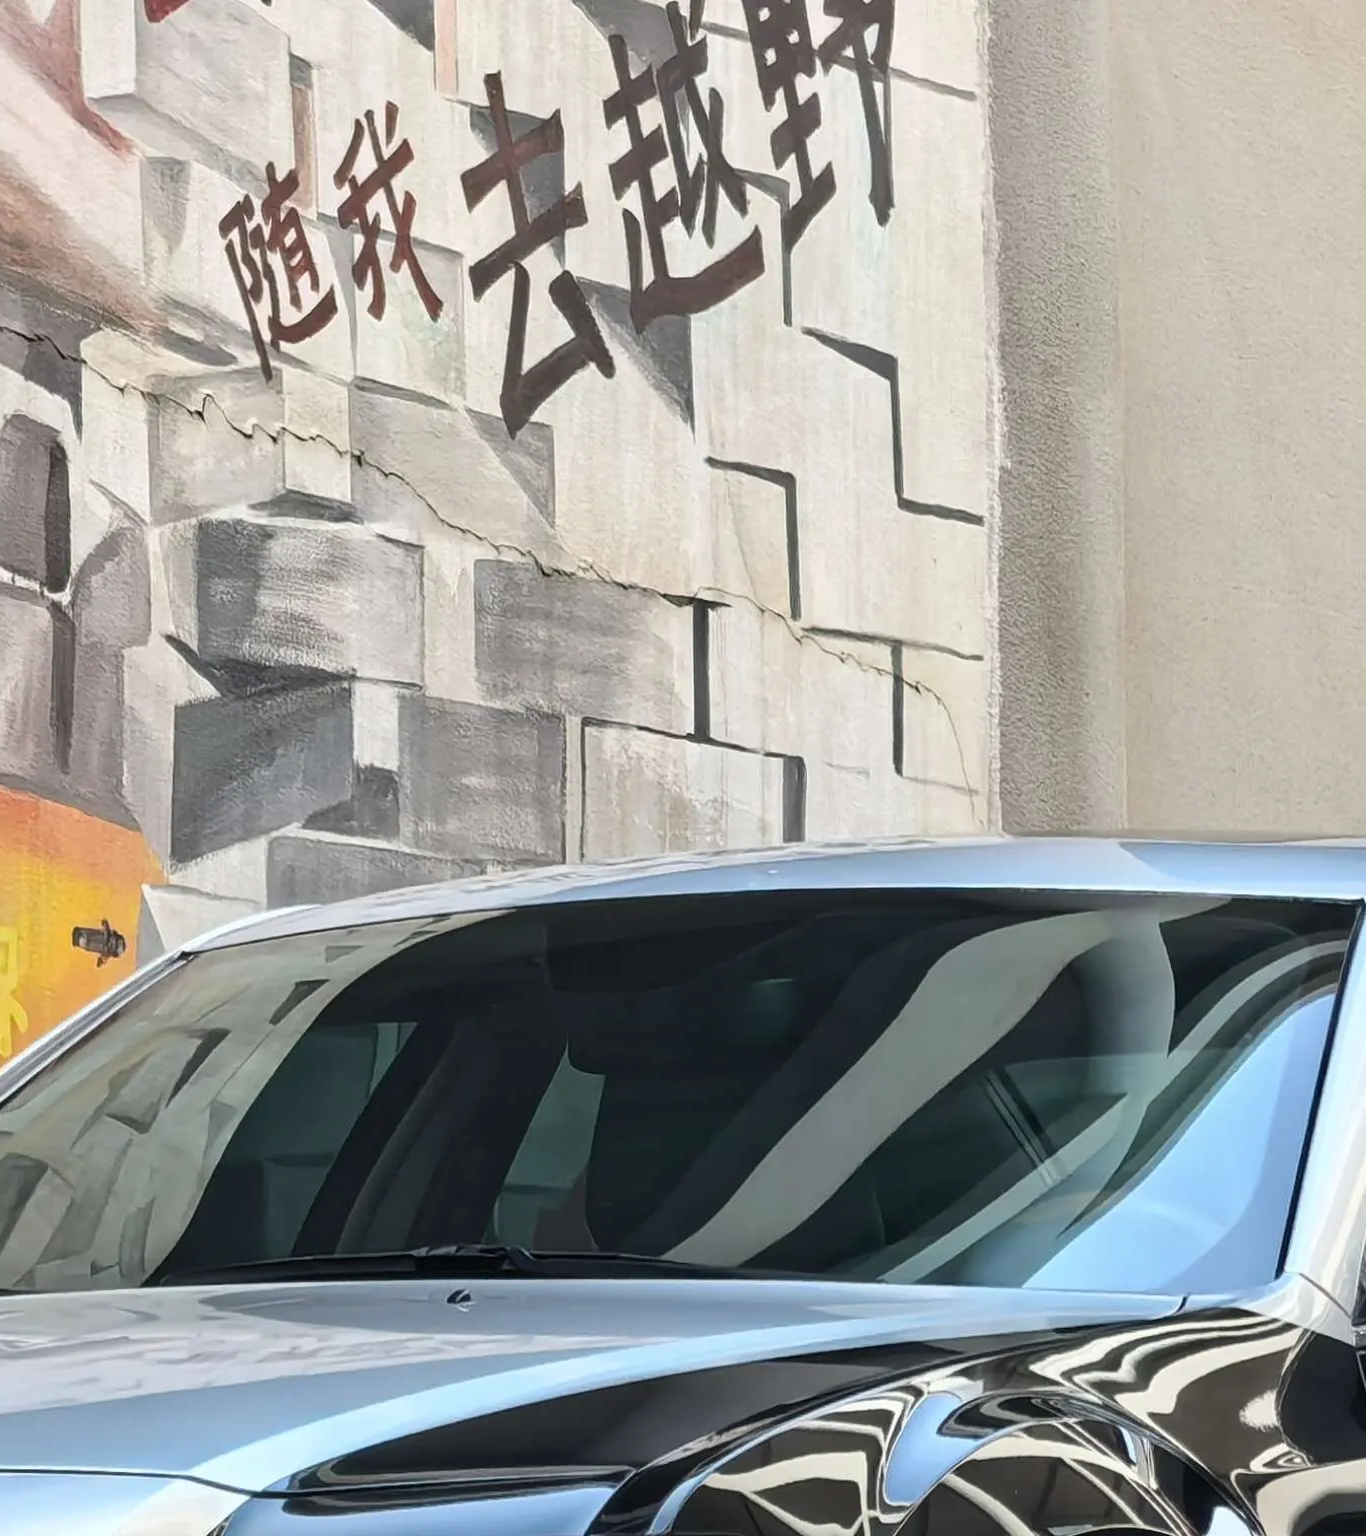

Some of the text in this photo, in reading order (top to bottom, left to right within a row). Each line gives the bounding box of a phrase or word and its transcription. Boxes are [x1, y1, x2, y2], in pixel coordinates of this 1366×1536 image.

[218, 0, 896, 439] 随我去越野
